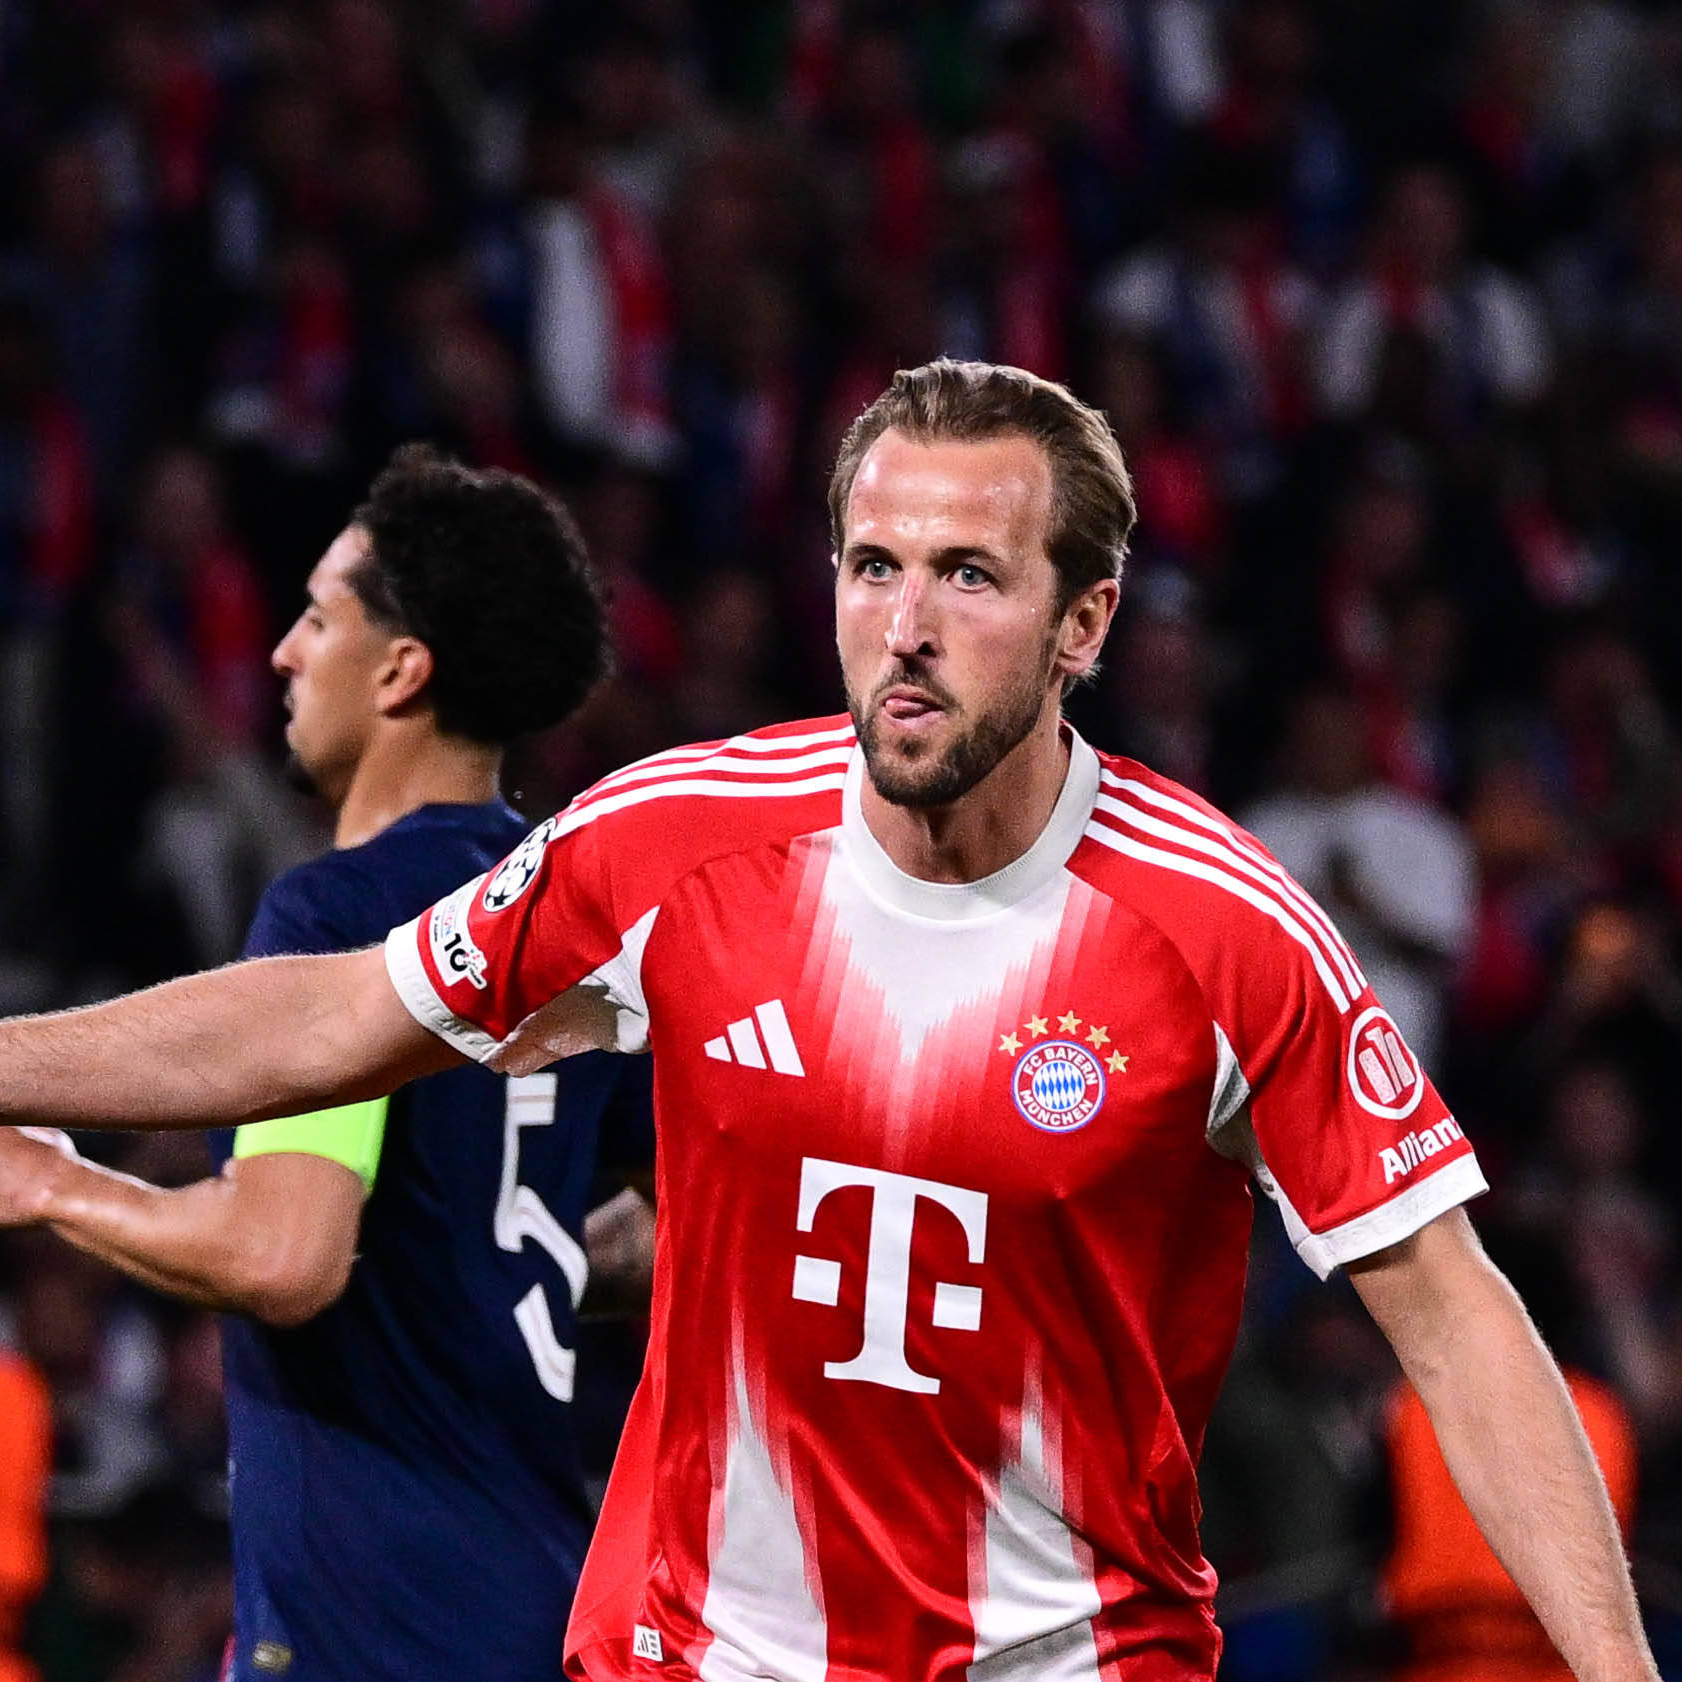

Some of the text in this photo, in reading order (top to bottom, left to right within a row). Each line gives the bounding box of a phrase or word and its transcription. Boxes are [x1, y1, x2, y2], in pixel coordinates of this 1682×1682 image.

[1023, 1047, 1098, 1085] FC BAYERN
[493, 1073, 589, 1403] 5
[792, 1156, 989, 1396] T
